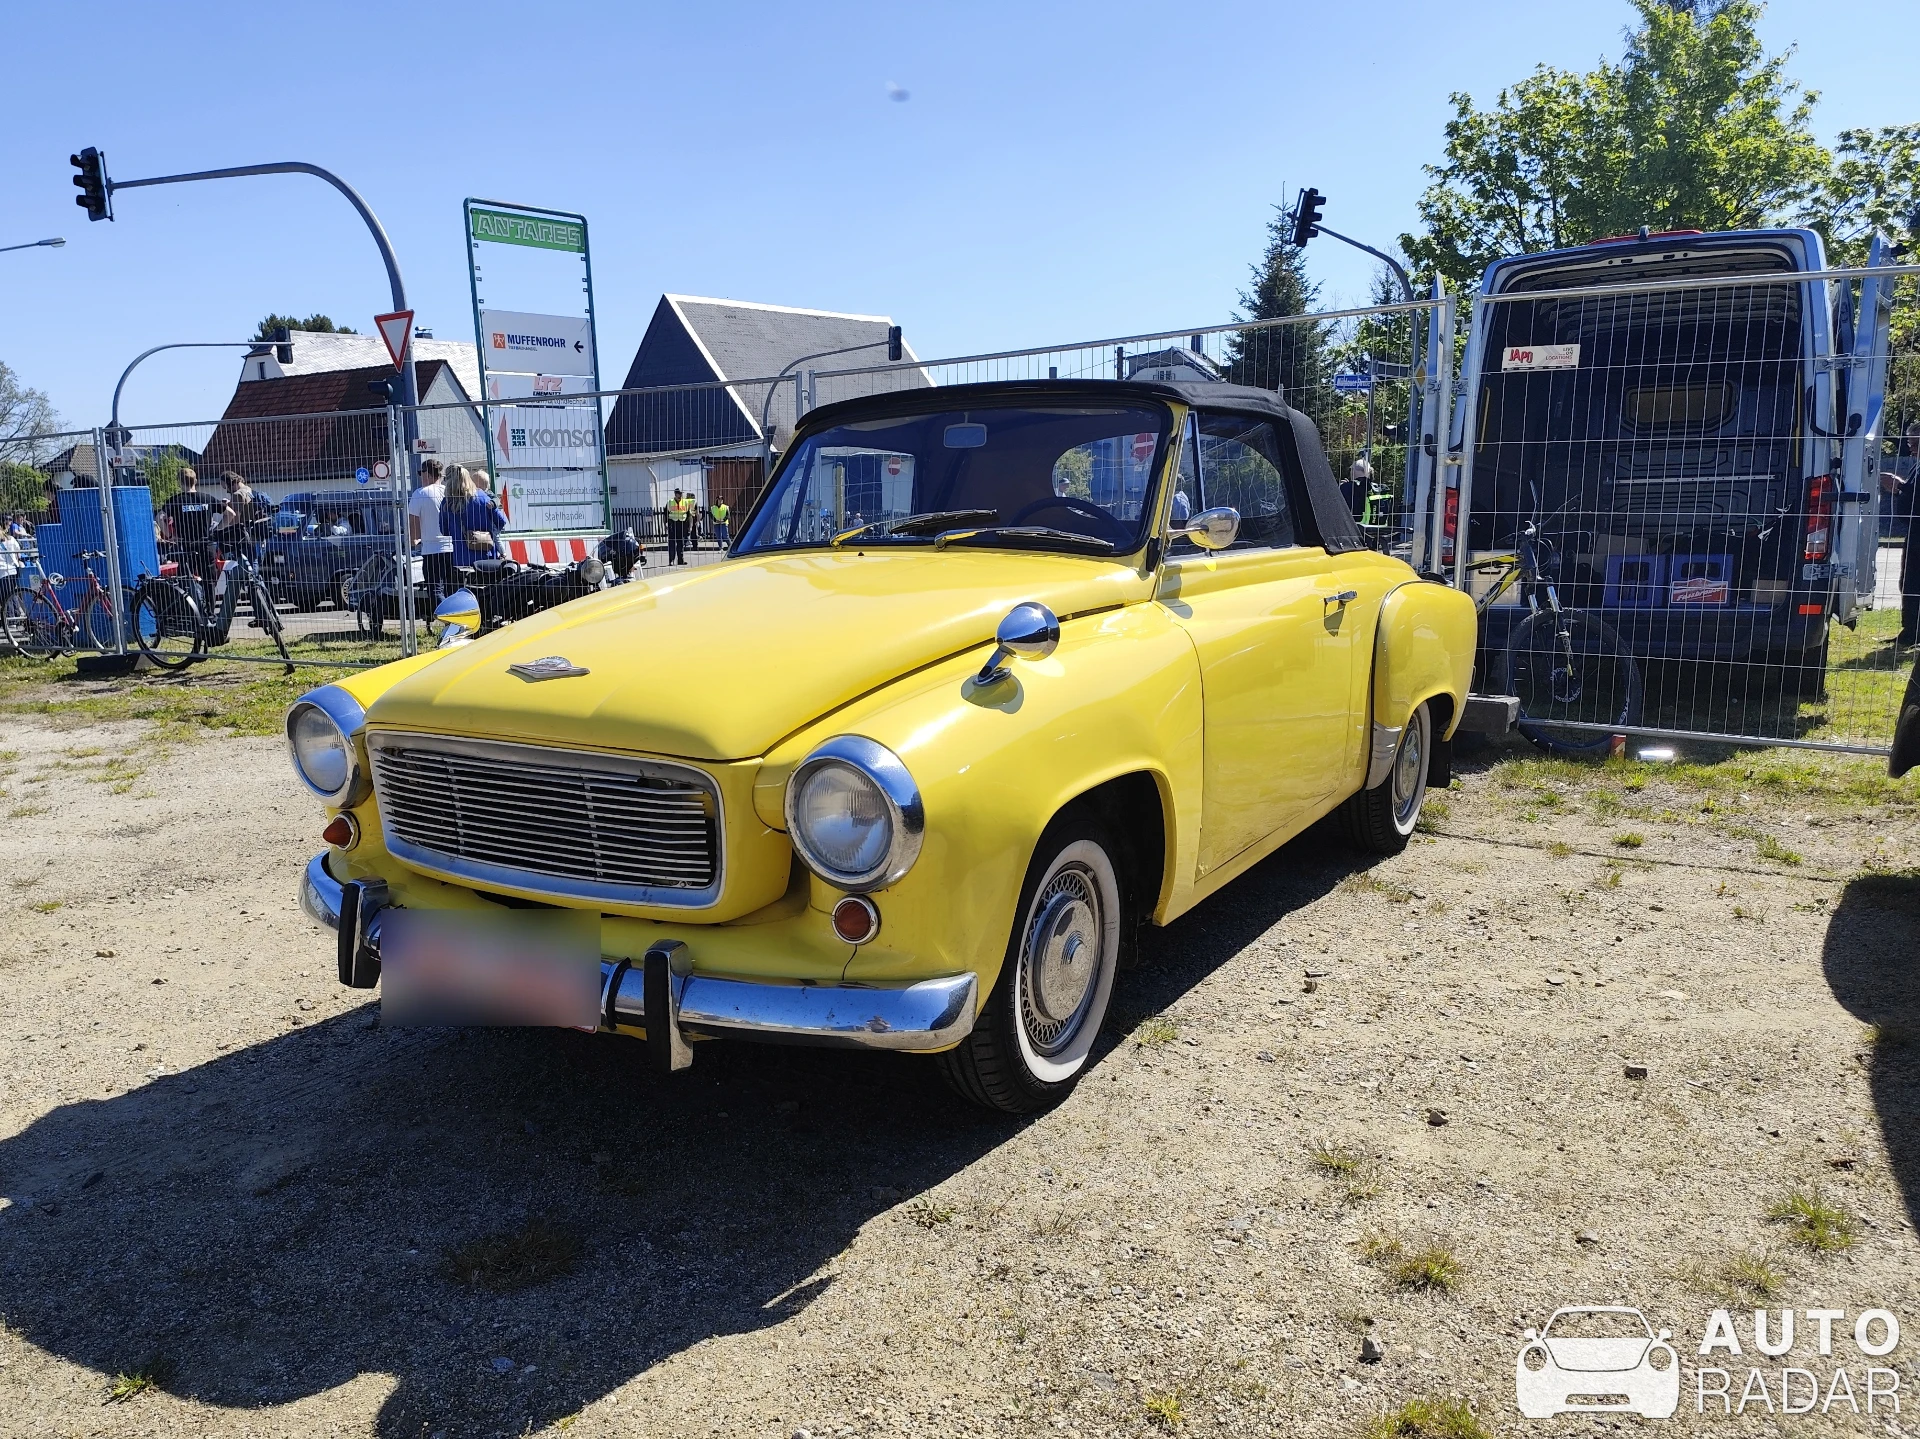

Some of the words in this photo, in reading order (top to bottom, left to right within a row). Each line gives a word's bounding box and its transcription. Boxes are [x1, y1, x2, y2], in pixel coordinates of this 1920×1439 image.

[477, 214, 581, 246] ANTARES
[507, 334, 566, 348] MUFFENROHR
[534, 376, 563, 391] LTZ
